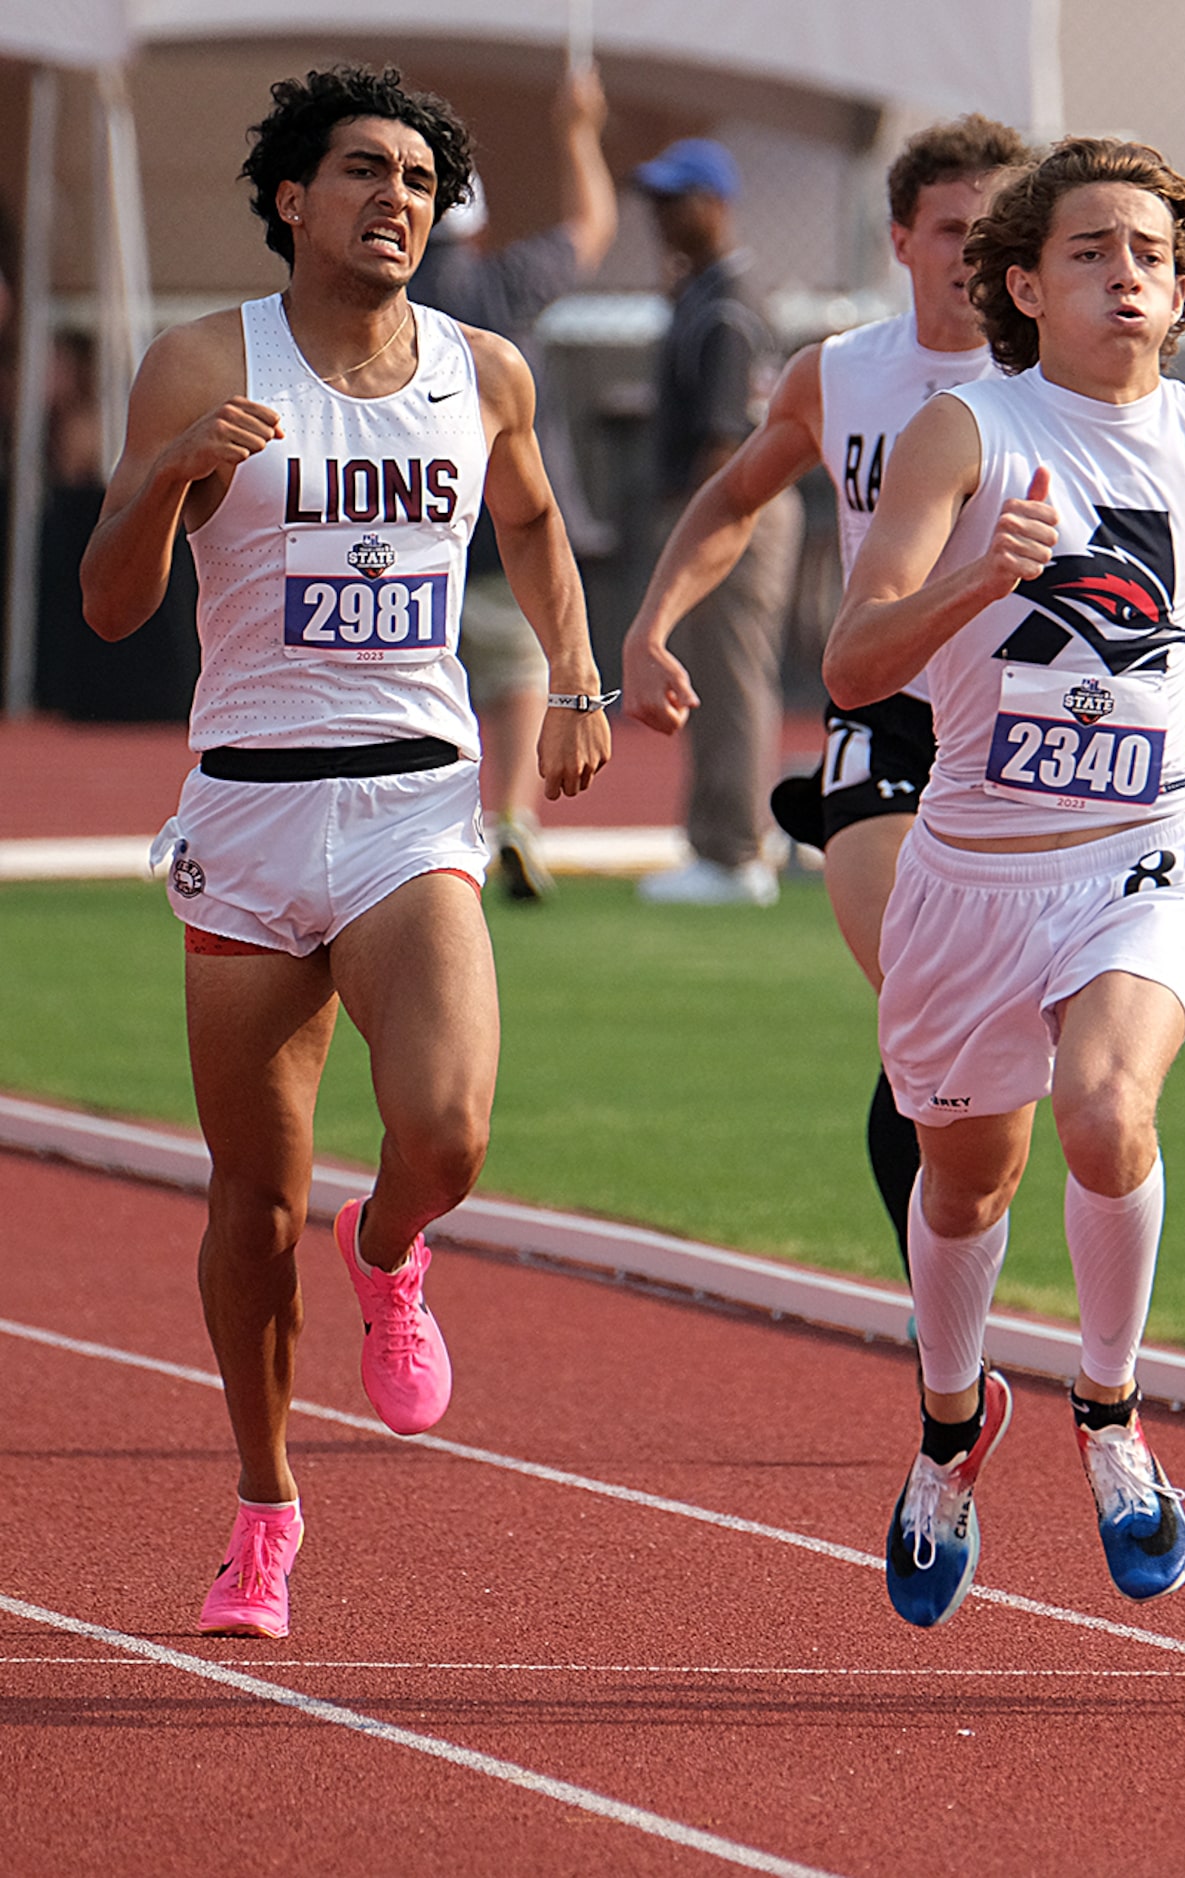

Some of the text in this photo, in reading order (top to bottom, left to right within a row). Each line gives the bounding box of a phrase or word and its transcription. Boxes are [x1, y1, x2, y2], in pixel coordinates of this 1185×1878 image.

[285, 457, 458, 524] LIONS
[348, 550, 394, 565] STATE
[302, 581, 433, 643] 2981
[356, 651, 385, 662] 2023
[1064, 694, 1114, 711] STATE
[1001, 721, 1152, 797] 2340
[1057, 798, 1086, 810] 2023
[1122, 849, 1177, 898] 8
